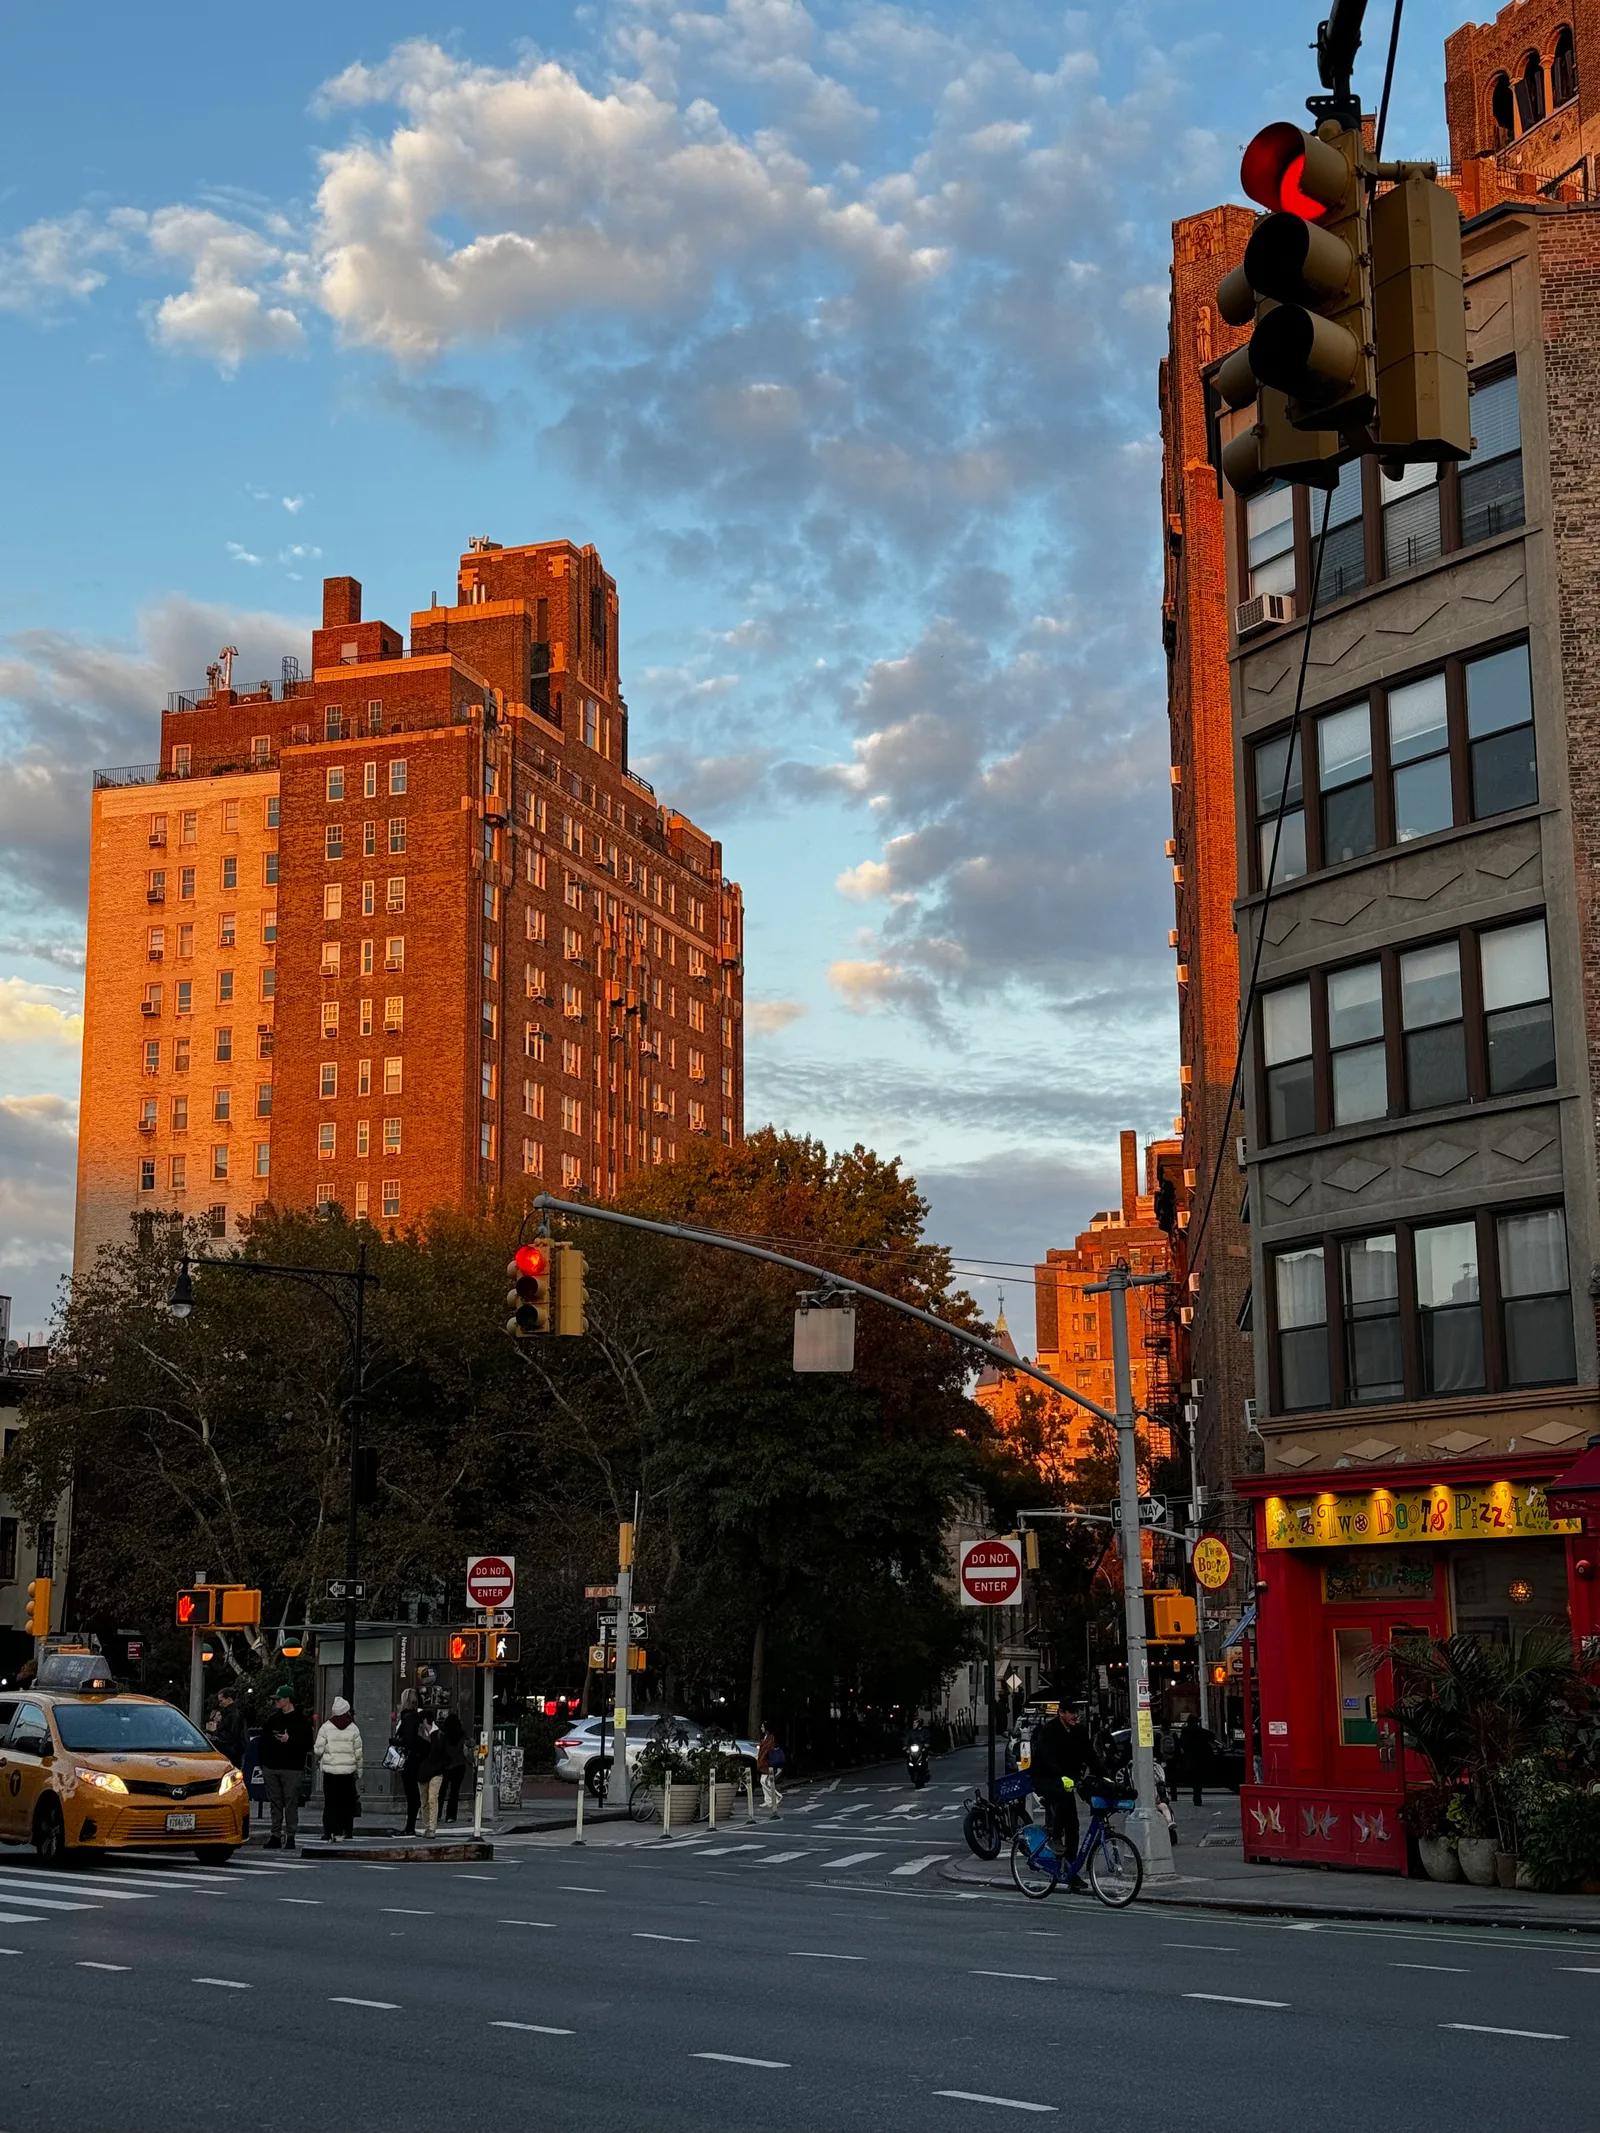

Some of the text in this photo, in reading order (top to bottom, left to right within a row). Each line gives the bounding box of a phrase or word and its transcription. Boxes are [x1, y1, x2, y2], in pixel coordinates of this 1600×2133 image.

[1141, 1504, 1159, 1516] WAY
[971, 1553, 1009, 1564] DO NOT
[476, 1566, 506, 1576] DO NOT
[332, 1585, 344, 1594] ONE
[974, 1581, 1008, 1592] ENTER
[477, 1588, 504, 1598] ENTER
[400, 1636, 408, 1678] Newsstand
